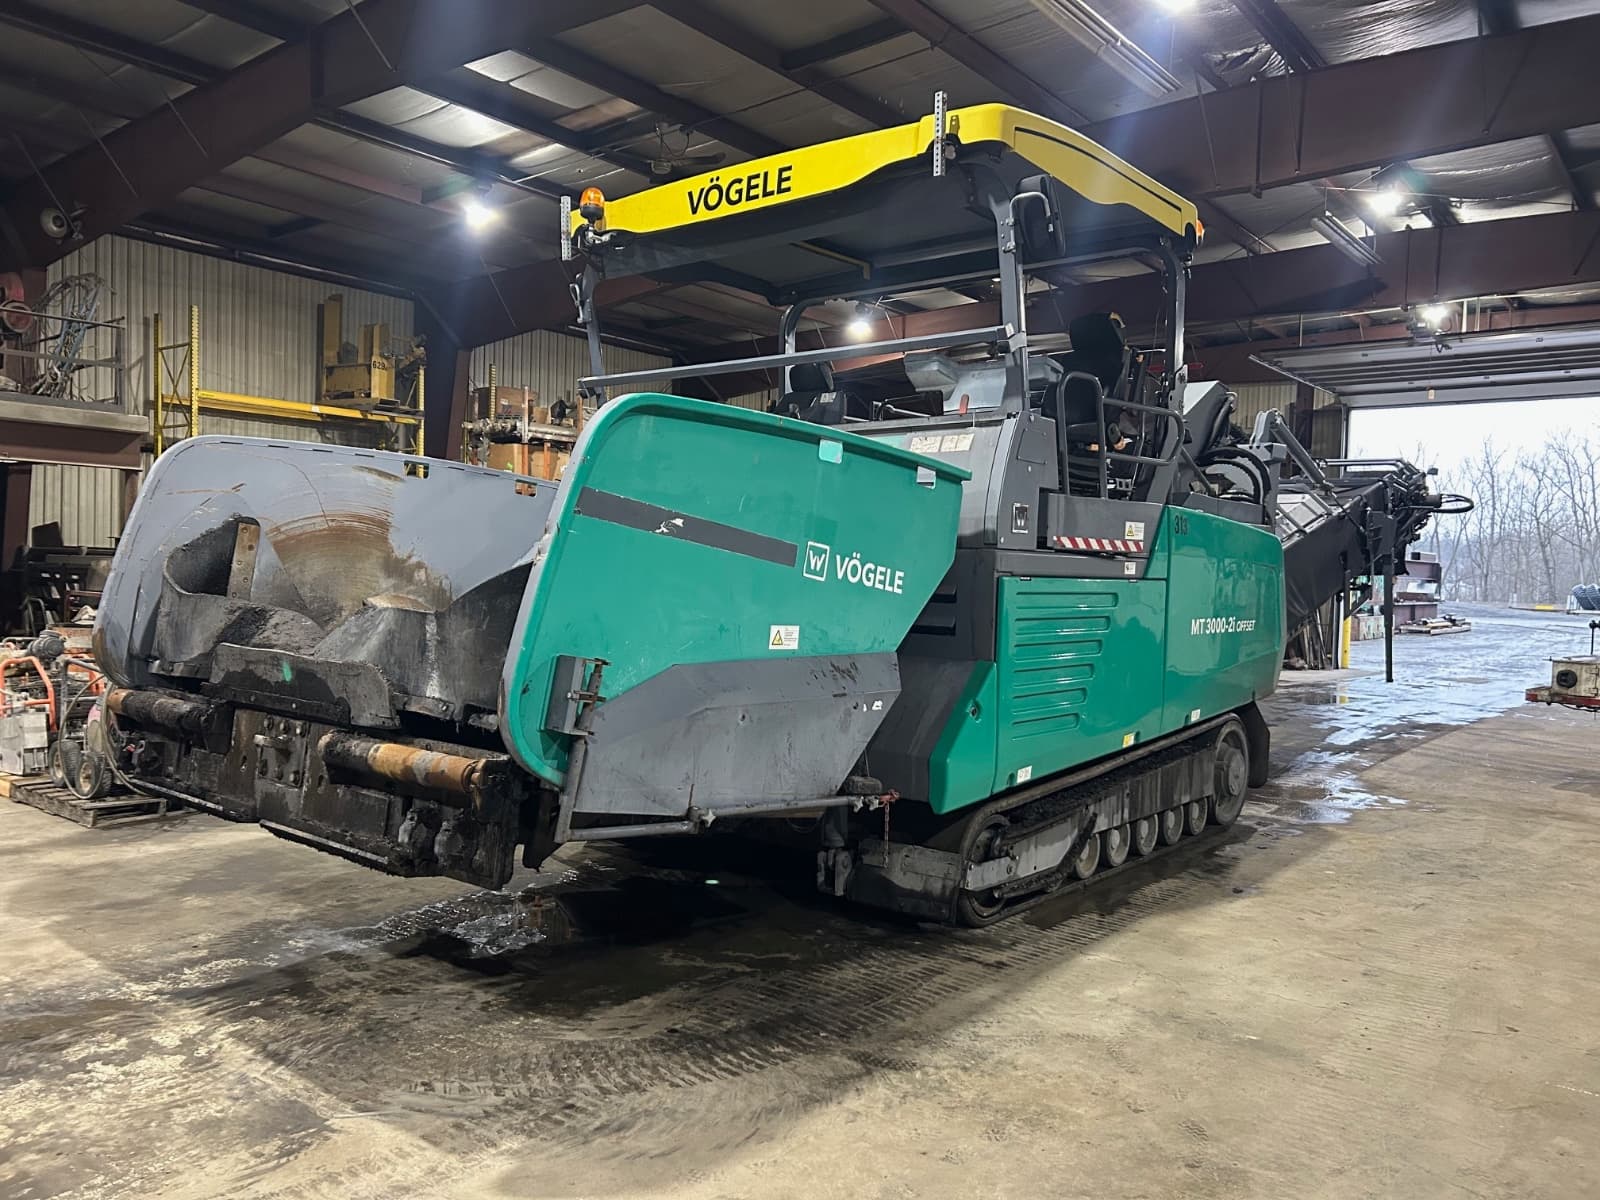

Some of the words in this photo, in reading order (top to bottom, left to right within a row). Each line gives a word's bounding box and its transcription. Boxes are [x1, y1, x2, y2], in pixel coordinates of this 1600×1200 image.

[688, 165, 792, 215] VÖGELE
[836, 552, 904, 594] VÖGELE
[1191, 618, 1205, 635] MT
